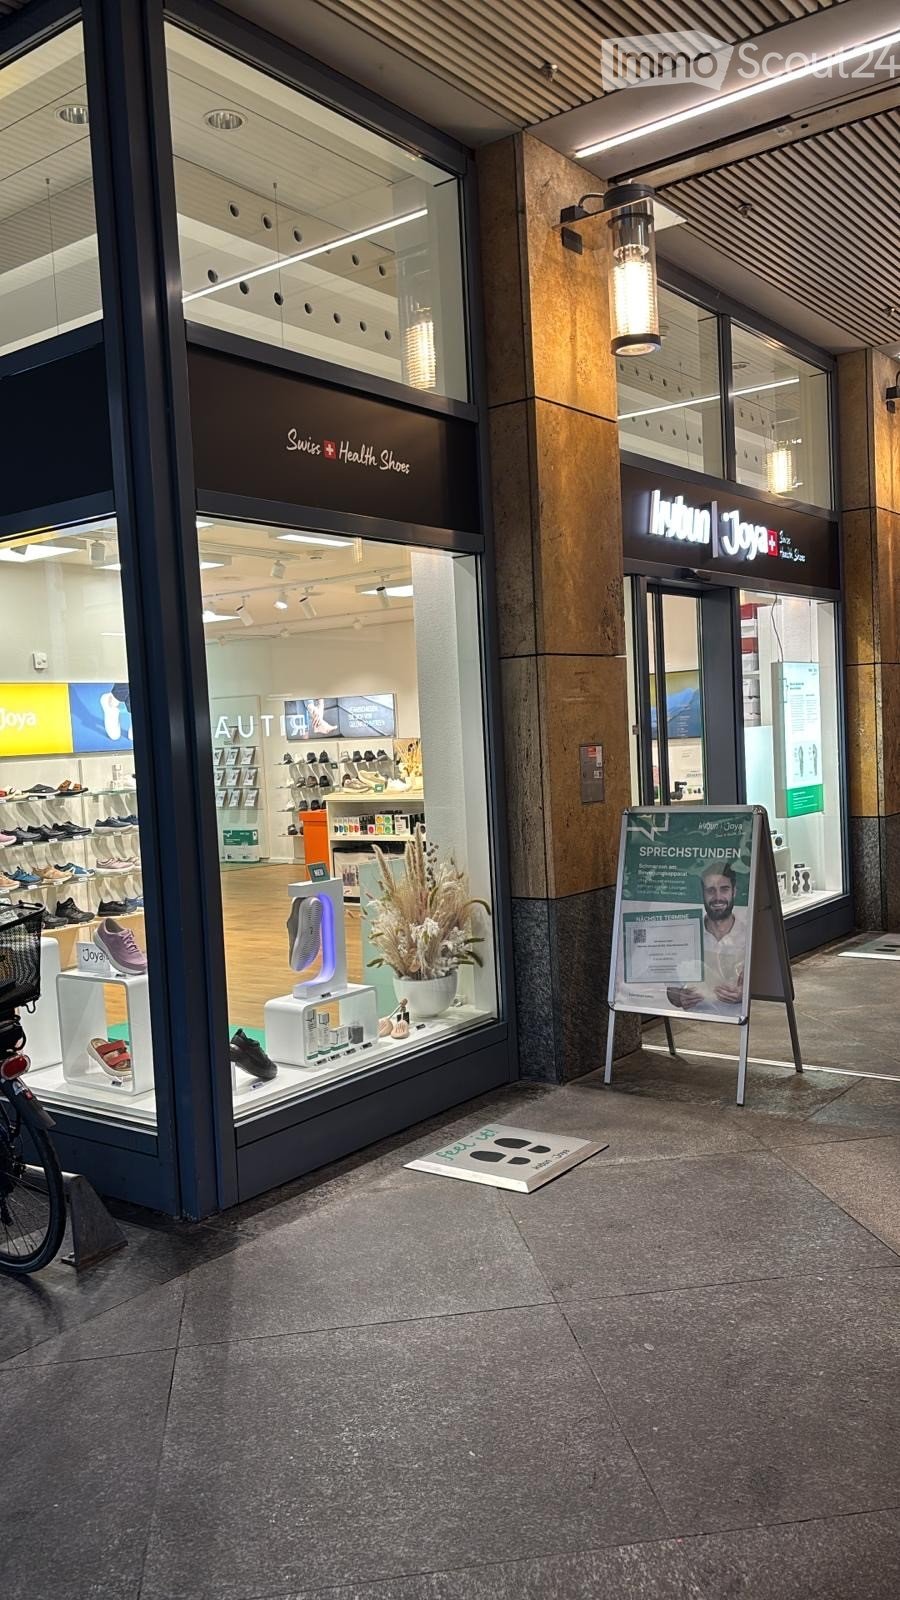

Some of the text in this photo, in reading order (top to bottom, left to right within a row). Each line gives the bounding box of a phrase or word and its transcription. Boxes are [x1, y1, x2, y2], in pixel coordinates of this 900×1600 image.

[286, 428, 411, 474] Swiss Health Shoes
[721, 510, 769, 561] Joya
[639, 846, 741, 858] SPRECHSTUNDEN
[435, 1142, 476, 1160] feel
